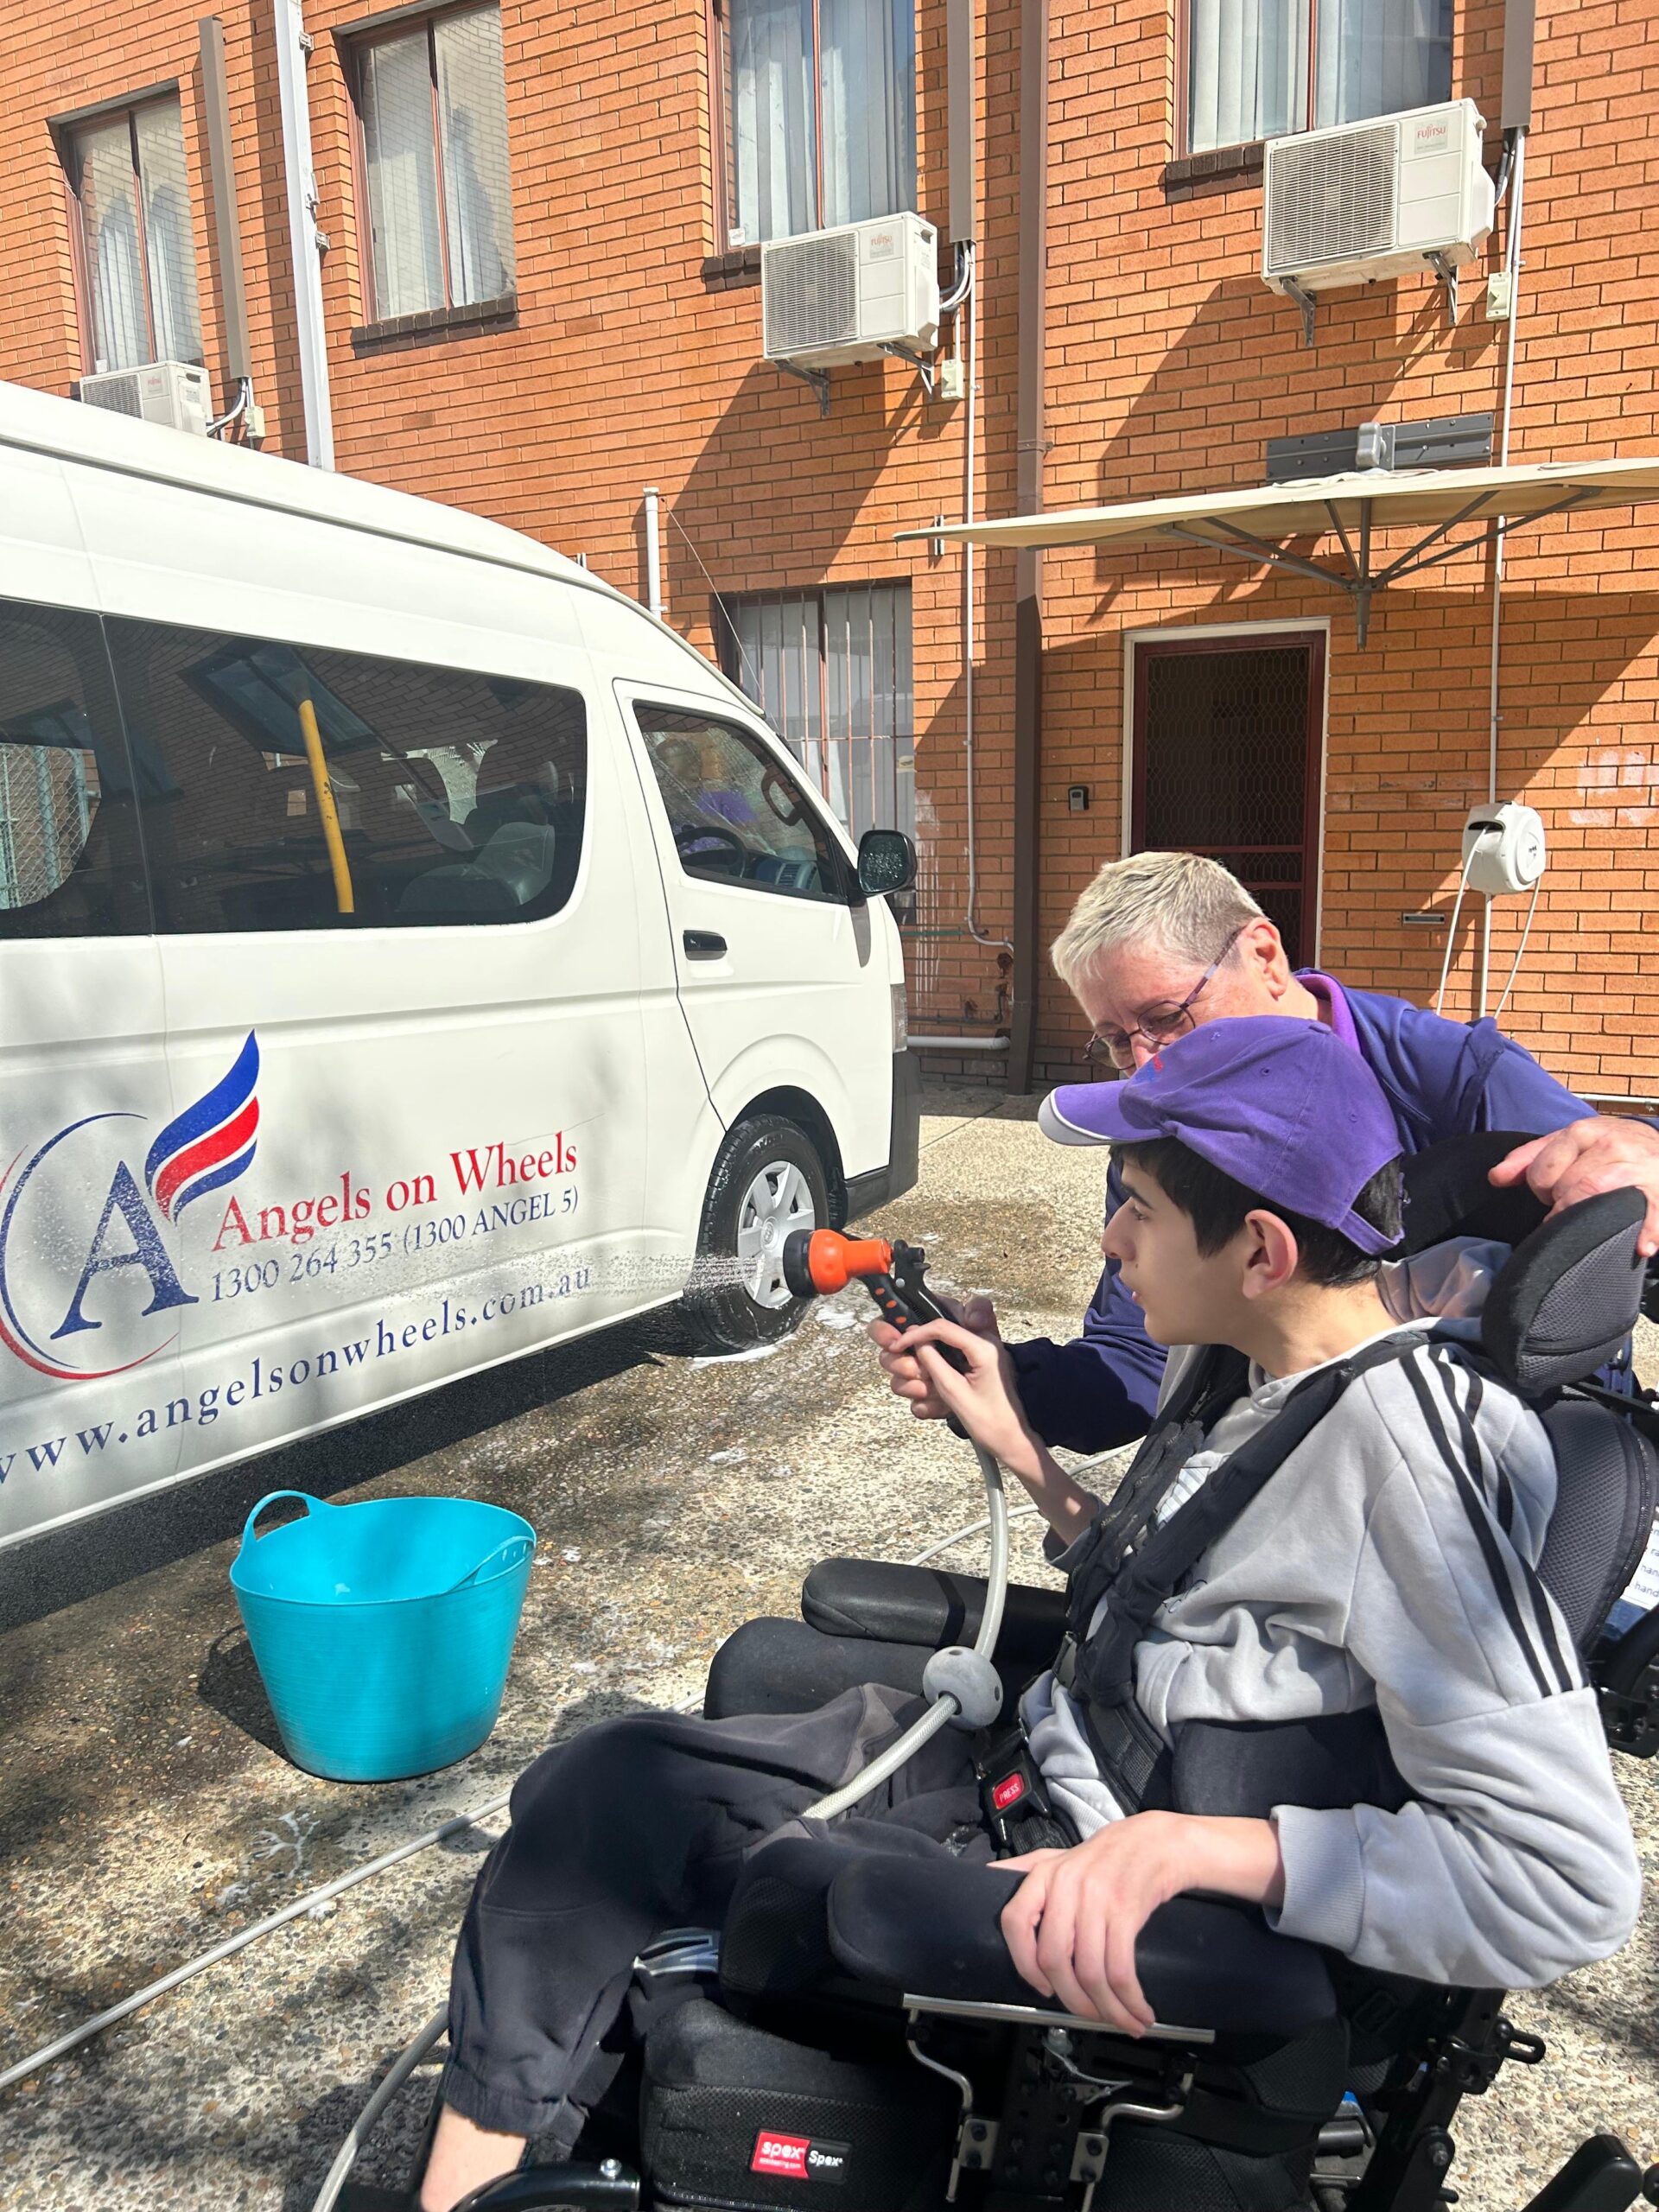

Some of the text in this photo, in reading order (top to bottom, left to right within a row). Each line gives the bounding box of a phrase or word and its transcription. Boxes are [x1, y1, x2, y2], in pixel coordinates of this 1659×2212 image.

[1417, 124, 1446, 138] FUJITSU
[212, 1131, 577, 1251] Angels on Wheels
[212, 1185, 579, 1301] 1300 264 355 (1300 ANGEL 5)
[999, 1783, 1020, 1802] PRESS
